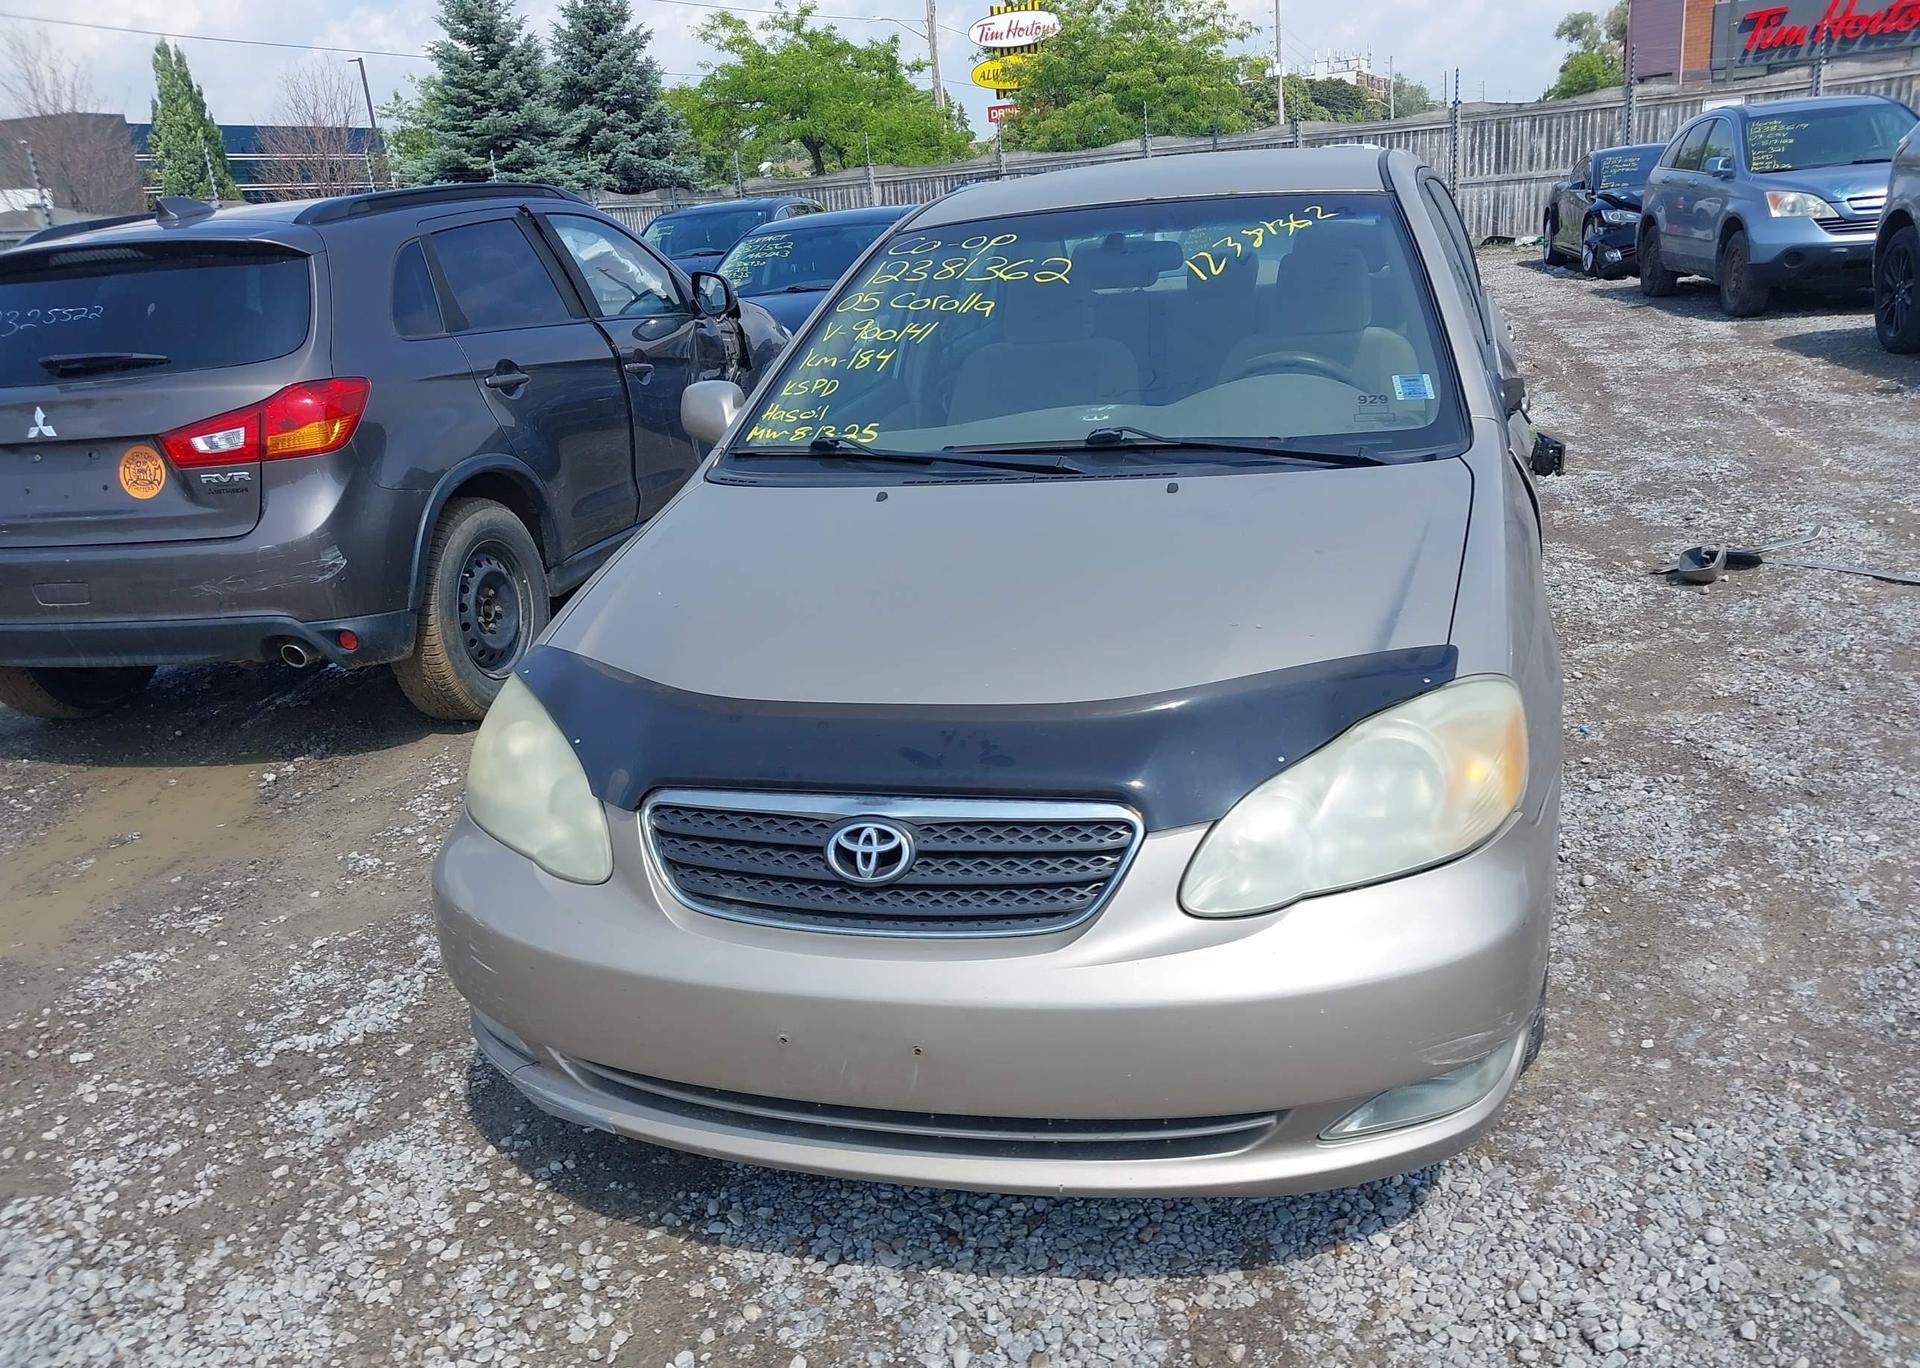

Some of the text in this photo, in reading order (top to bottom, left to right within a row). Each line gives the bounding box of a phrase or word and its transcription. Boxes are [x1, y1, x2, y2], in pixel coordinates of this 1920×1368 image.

[977, 19, 1057, 43] Tim Hortons
[1742, 6, 1811, 51] Tim
[863, 257, 1072, 289] 12381362
[836, 292, 995, 318] 05 Corolla
[0, 305, 103, 338] 325522
[1358, 394, 1388, 405] 929
[200, 471, 252, 484] RVR
